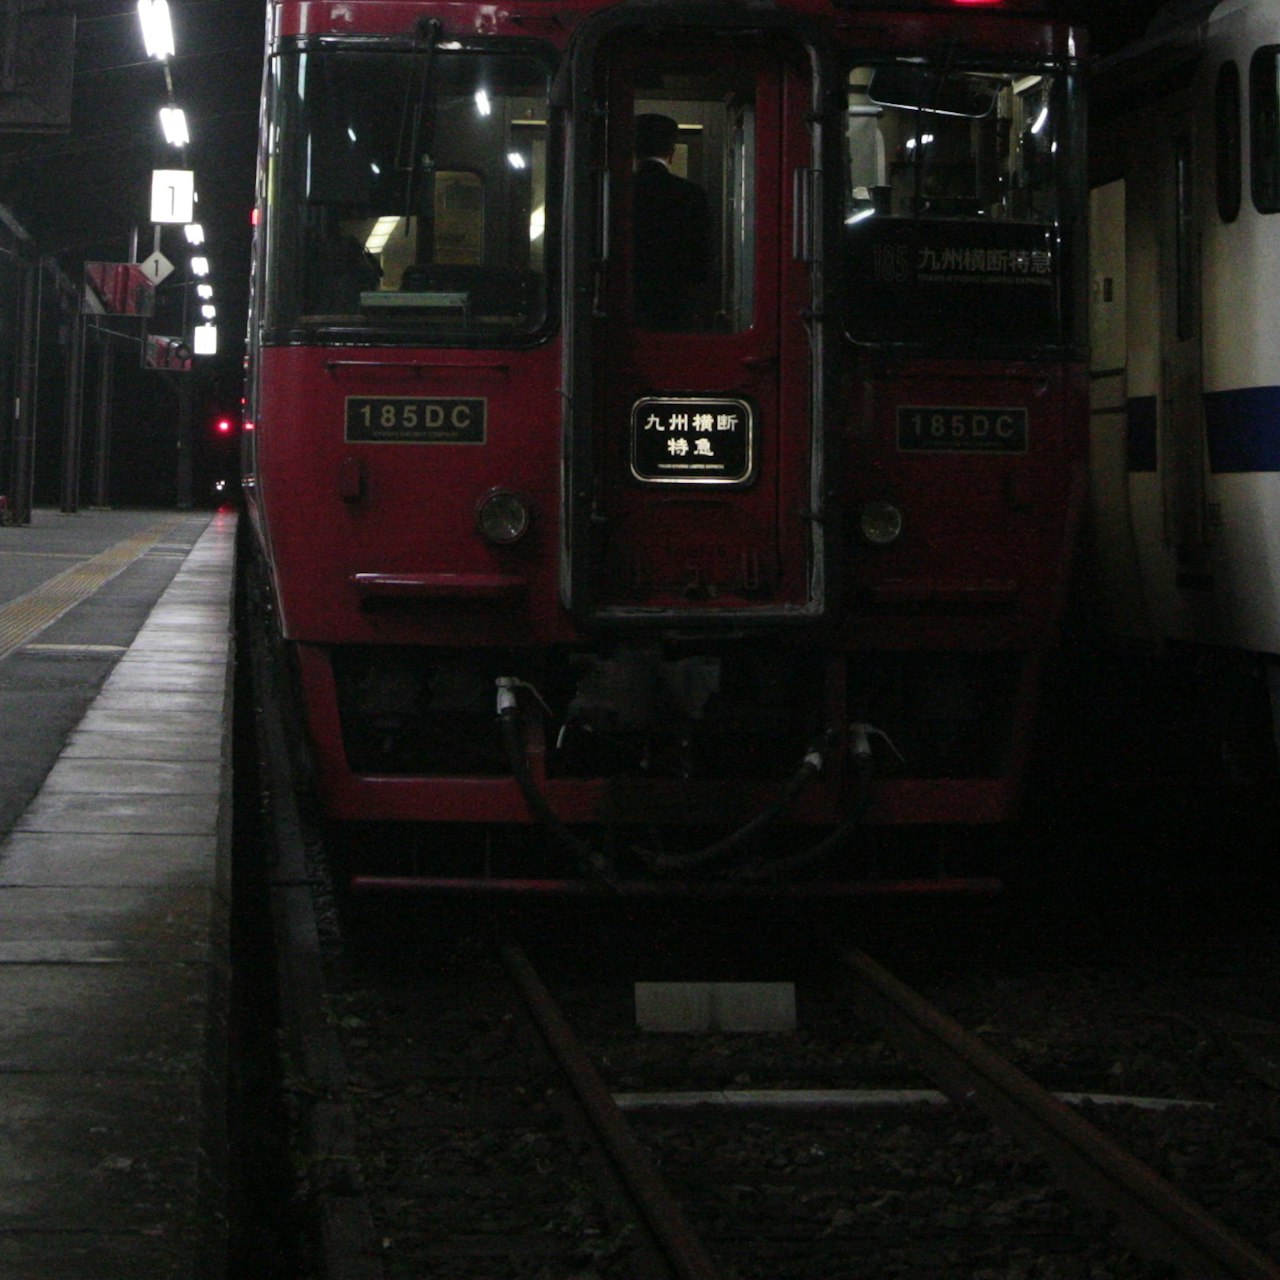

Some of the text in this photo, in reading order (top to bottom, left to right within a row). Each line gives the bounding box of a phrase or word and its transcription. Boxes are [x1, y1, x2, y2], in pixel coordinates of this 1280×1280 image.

[167, 184, 175, 216] 1
[153, 258, 158, 277] 1
[917, 246, 1053, 274] 九州横断特急
[360, 404, 471, 428] 185DC
[644, 413, 739, 432] 九州横断
[911, 414, 1014, 438] 185DC
[667, 437, 715, 456] 特急
